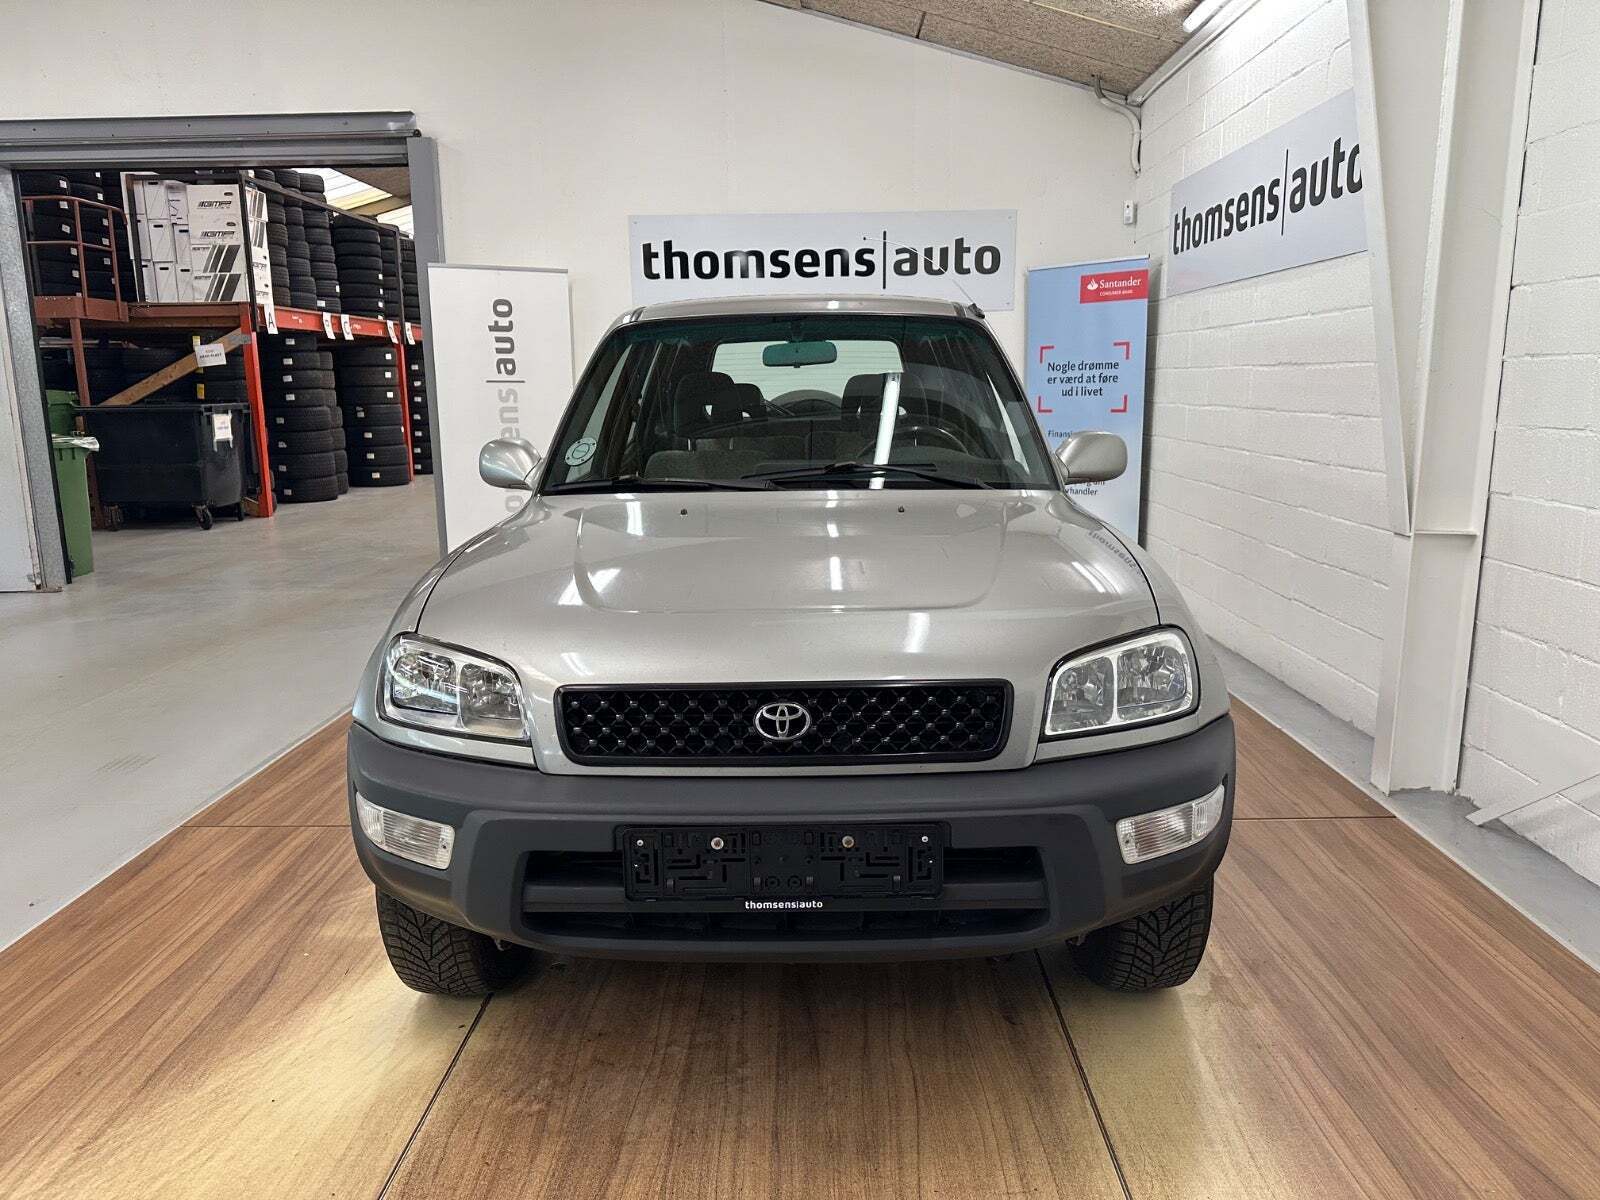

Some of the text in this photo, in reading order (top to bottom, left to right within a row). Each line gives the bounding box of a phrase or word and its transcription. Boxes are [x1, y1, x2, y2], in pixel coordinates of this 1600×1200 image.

[1099, 276, 1141, 289] Santander
[268, 312, 276, 329] A
[1047, 360, 1119, 374] Nogle drømme
[1060, 374, 1083, 384] værd
[1086, 374, 1096, 384] at
[1098, 373, 1118, 384] føre
[1061, 386, 1104, 397] ud i livet
